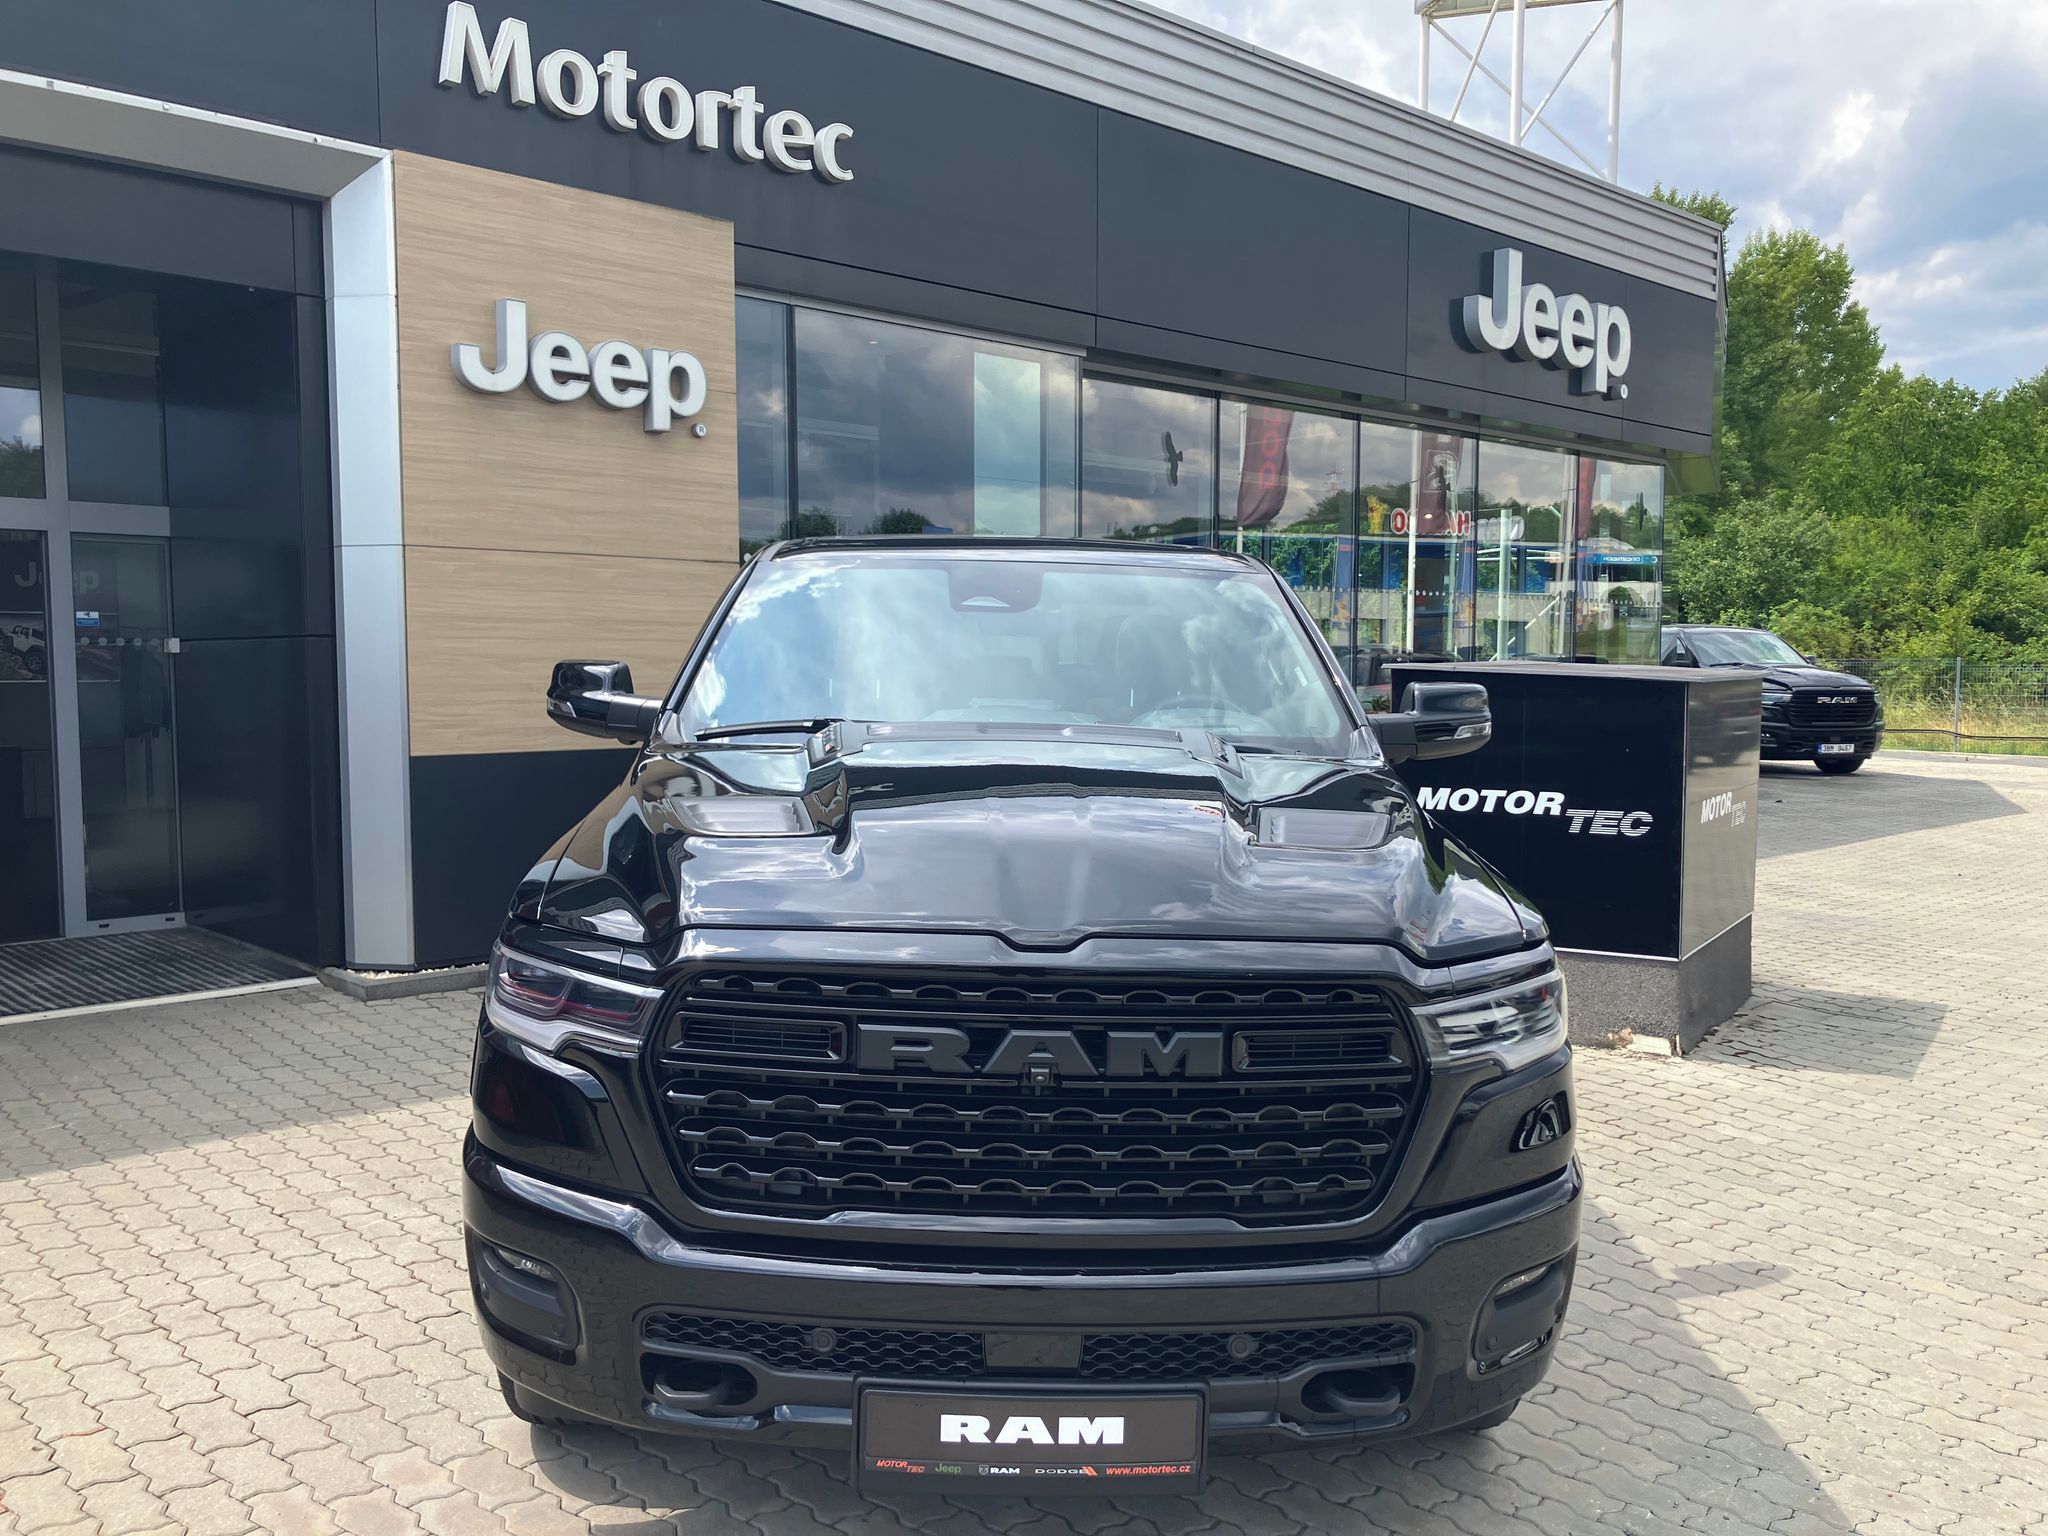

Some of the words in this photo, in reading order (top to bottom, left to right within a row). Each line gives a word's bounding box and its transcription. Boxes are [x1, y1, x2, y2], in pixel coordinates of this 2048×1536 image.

[438, 0, 855, 184] Motortec
[1463, 247, 1632, 395] Jeep
[450, 297, 707, 434] Jeep
[1817, 696, 1858, 704] RAM
[1416, 786, 1566, 816] MOTOR
[1565, 808, 1654, 837] TEC
[1701, 791, 1732, 825] MOTOR
[856, 1023, 1224, 1077] RAM
[940, 1414, 1125, 1445] RAM
[876, 1459, 909, 1468] MOTOR
[906, 1465, 925, 1473] TEC
[935, 1463, 962, 1475] Jeep
[1106, 1465, 1191, 1475] www.motortec.cz
